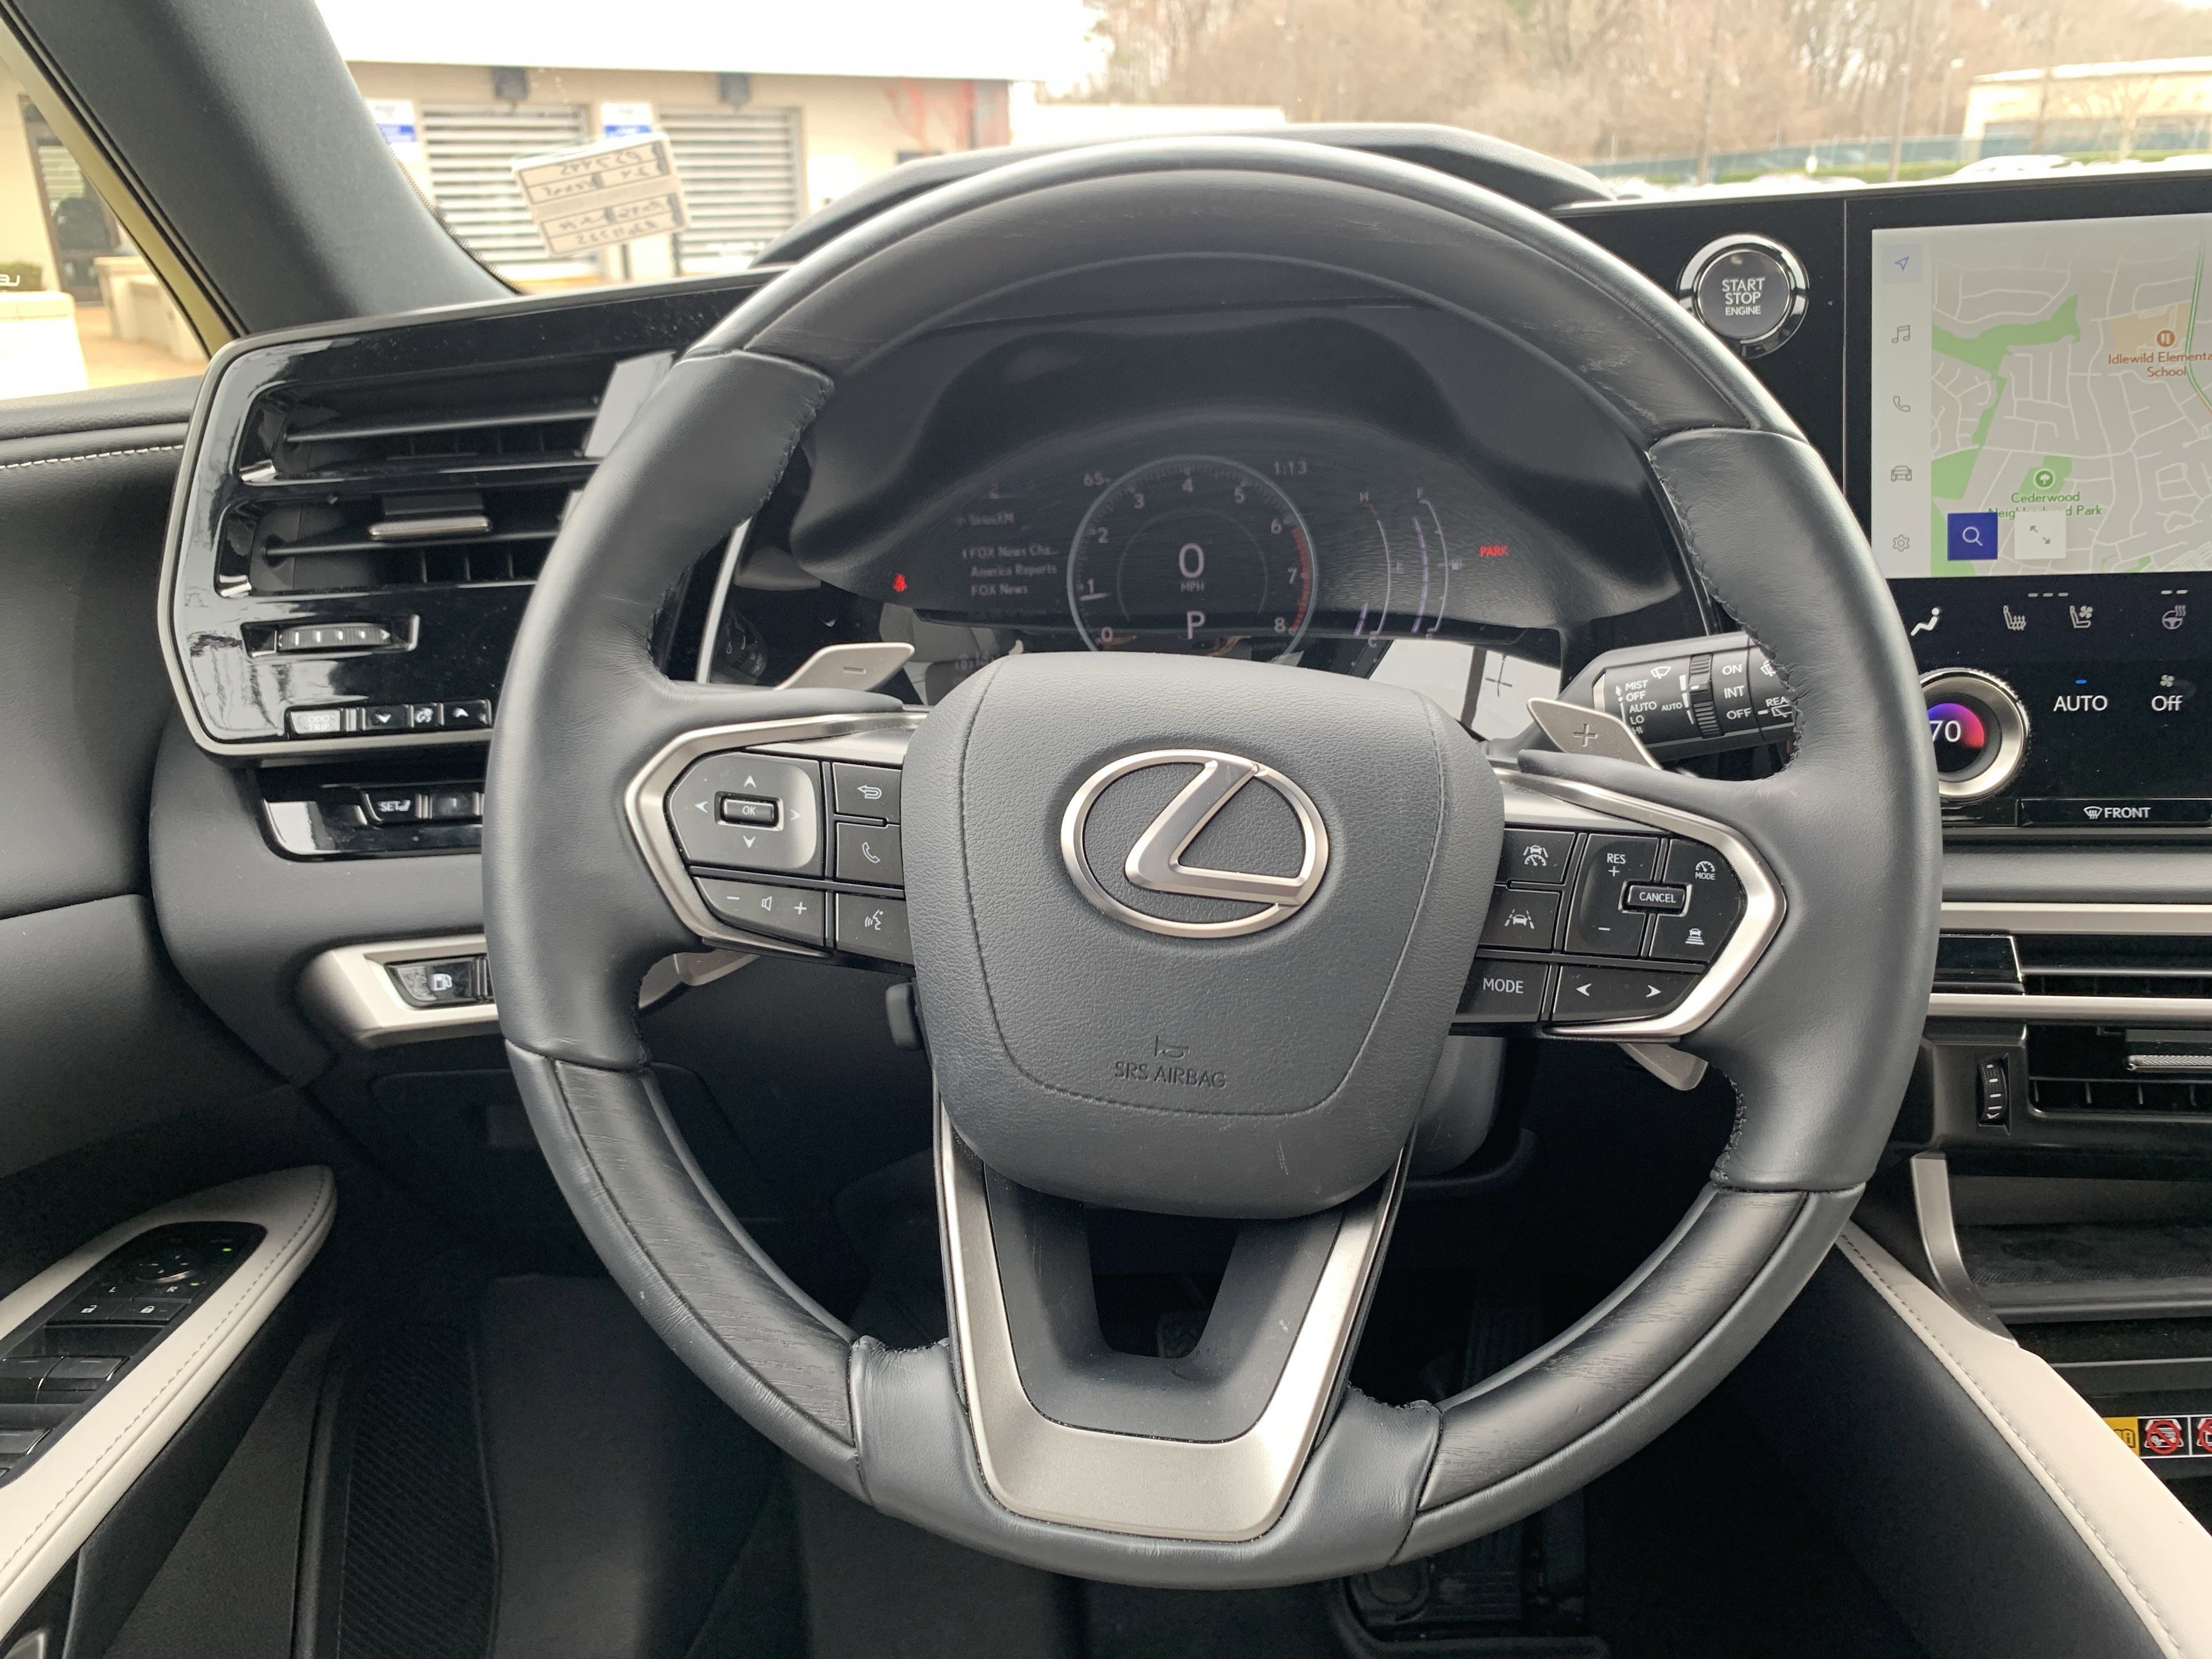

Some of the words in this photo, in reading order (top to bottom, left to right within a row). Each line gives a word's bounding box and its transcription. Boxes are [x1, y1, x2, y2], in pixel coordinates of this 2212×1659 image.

[1722, 278, 1766, 292] START
[1725, 291, 1761, 304] STOP
[1725, 306, 1761, 315] ENGINE
[2108, 352, 2154, 364] Idlewild
[2147, 365, 2187, 377] School
[1182, 478, 1194, 493] 4
[1133, 493, 1145, 509] 3
[1234, 486, 1245, 503] 5
[2011, 491, 2080, 503] Cederwood
[1271, 517, 1282, 534] 6
[1098, 527, 1109, 543] 2
[1480, 545, 1508, 557] PARK
[1287, 567, 1297, 584] 7
[1086, 578, 1095, 594] 1
[1181, 580, 1204, 592] MPH
[1186, 610, 1206, 640] P
[1274, 616, 1285, 633] 8
[1101, 626, 1114, 642] 0
[1722, 663, 1742, 675] ON
[1625, 680, 1649, 691] MIST
[1724, 685, 1745, 699] INT
[1626, 691, 1646, 702] OFF
[1765, 695, 1790, 707] REA
[1629, 701, 1657, 714] AUTO
[1661, 702, 1683, 712] AUTO
[2053, 695, 2108, 712] AUTO
[2151, 695, 2183, 712] Off
[1629, 715, 1644, 725] LO
[1726, 708, 1751, 720] OFF
[1929, 720, 1961, 742] 70
[377, 800, 400, 812] SET
[742, 805, 757, 816] OK
[2104, 807, 2151, 819] FRONT
[1606, 853, 1626, 865] RES
[1695, 872, 1716, 881] MODE
[1639, 891, 1677, 904] CANCEL
[1482, 978, 1524, 994] MODE
[1114, 1060, 1149, 1081] SRS
[1154, 1065, 1227, 1089] AIRBAG
